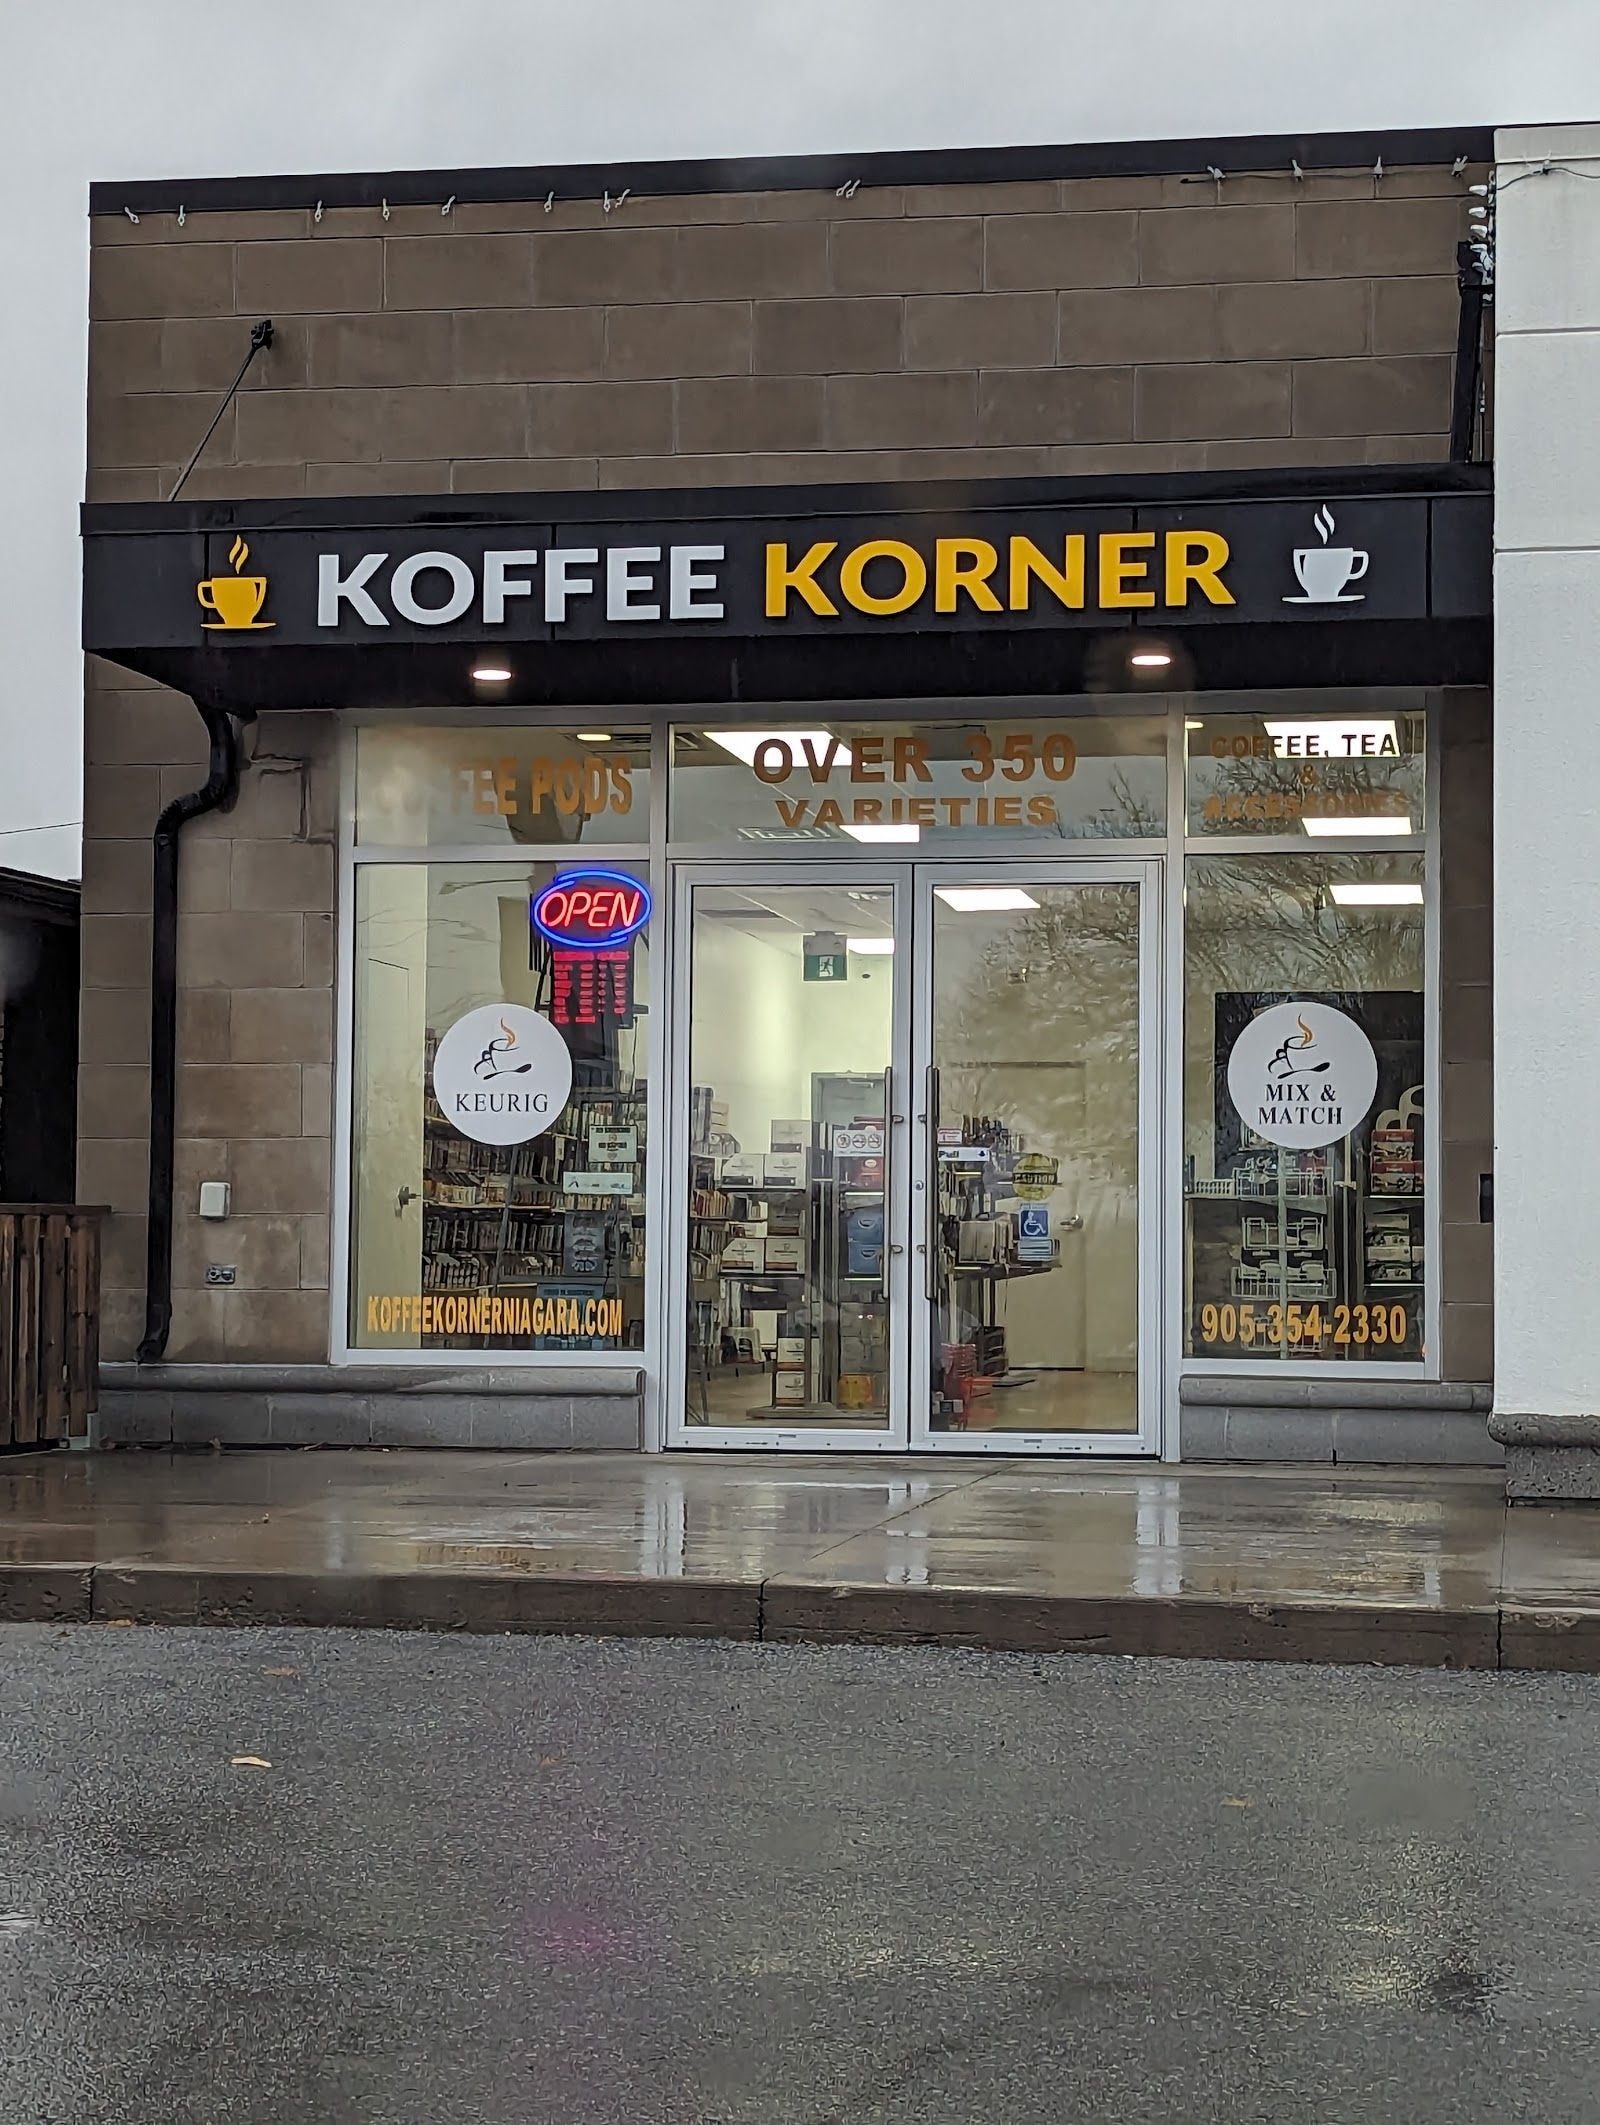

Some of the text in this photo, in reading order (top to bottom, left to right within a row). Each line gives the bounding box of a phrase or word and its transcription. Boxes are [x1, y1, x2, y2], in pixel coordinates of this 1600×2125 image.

[317, 530, 1236, 627] KOFFEE KORNER
[753, 734, 1076, 784] OVER 350
[1210, 733, 1397, 758] COFFEE, TEA
[531, 756, 633, 816] PODS
[1301, 764, 1320, 787] &
[775, 796, 1056, 828] VARIETIES
[540, 891, 640, 927] OPEN
[455, 1093, 548, 1113] KEURIG
[1265, 1084, 1337, 1102] MIX &
[1257, 1107, 1342, 1125] MATCH
[1014, 1173, 1055, 1183] CAUTION
[367, 1295, 623, 1337] KOFFEEKORNERNIAGARA.COM
[1201, 1303, 1407, 1344] 905-354-2330
